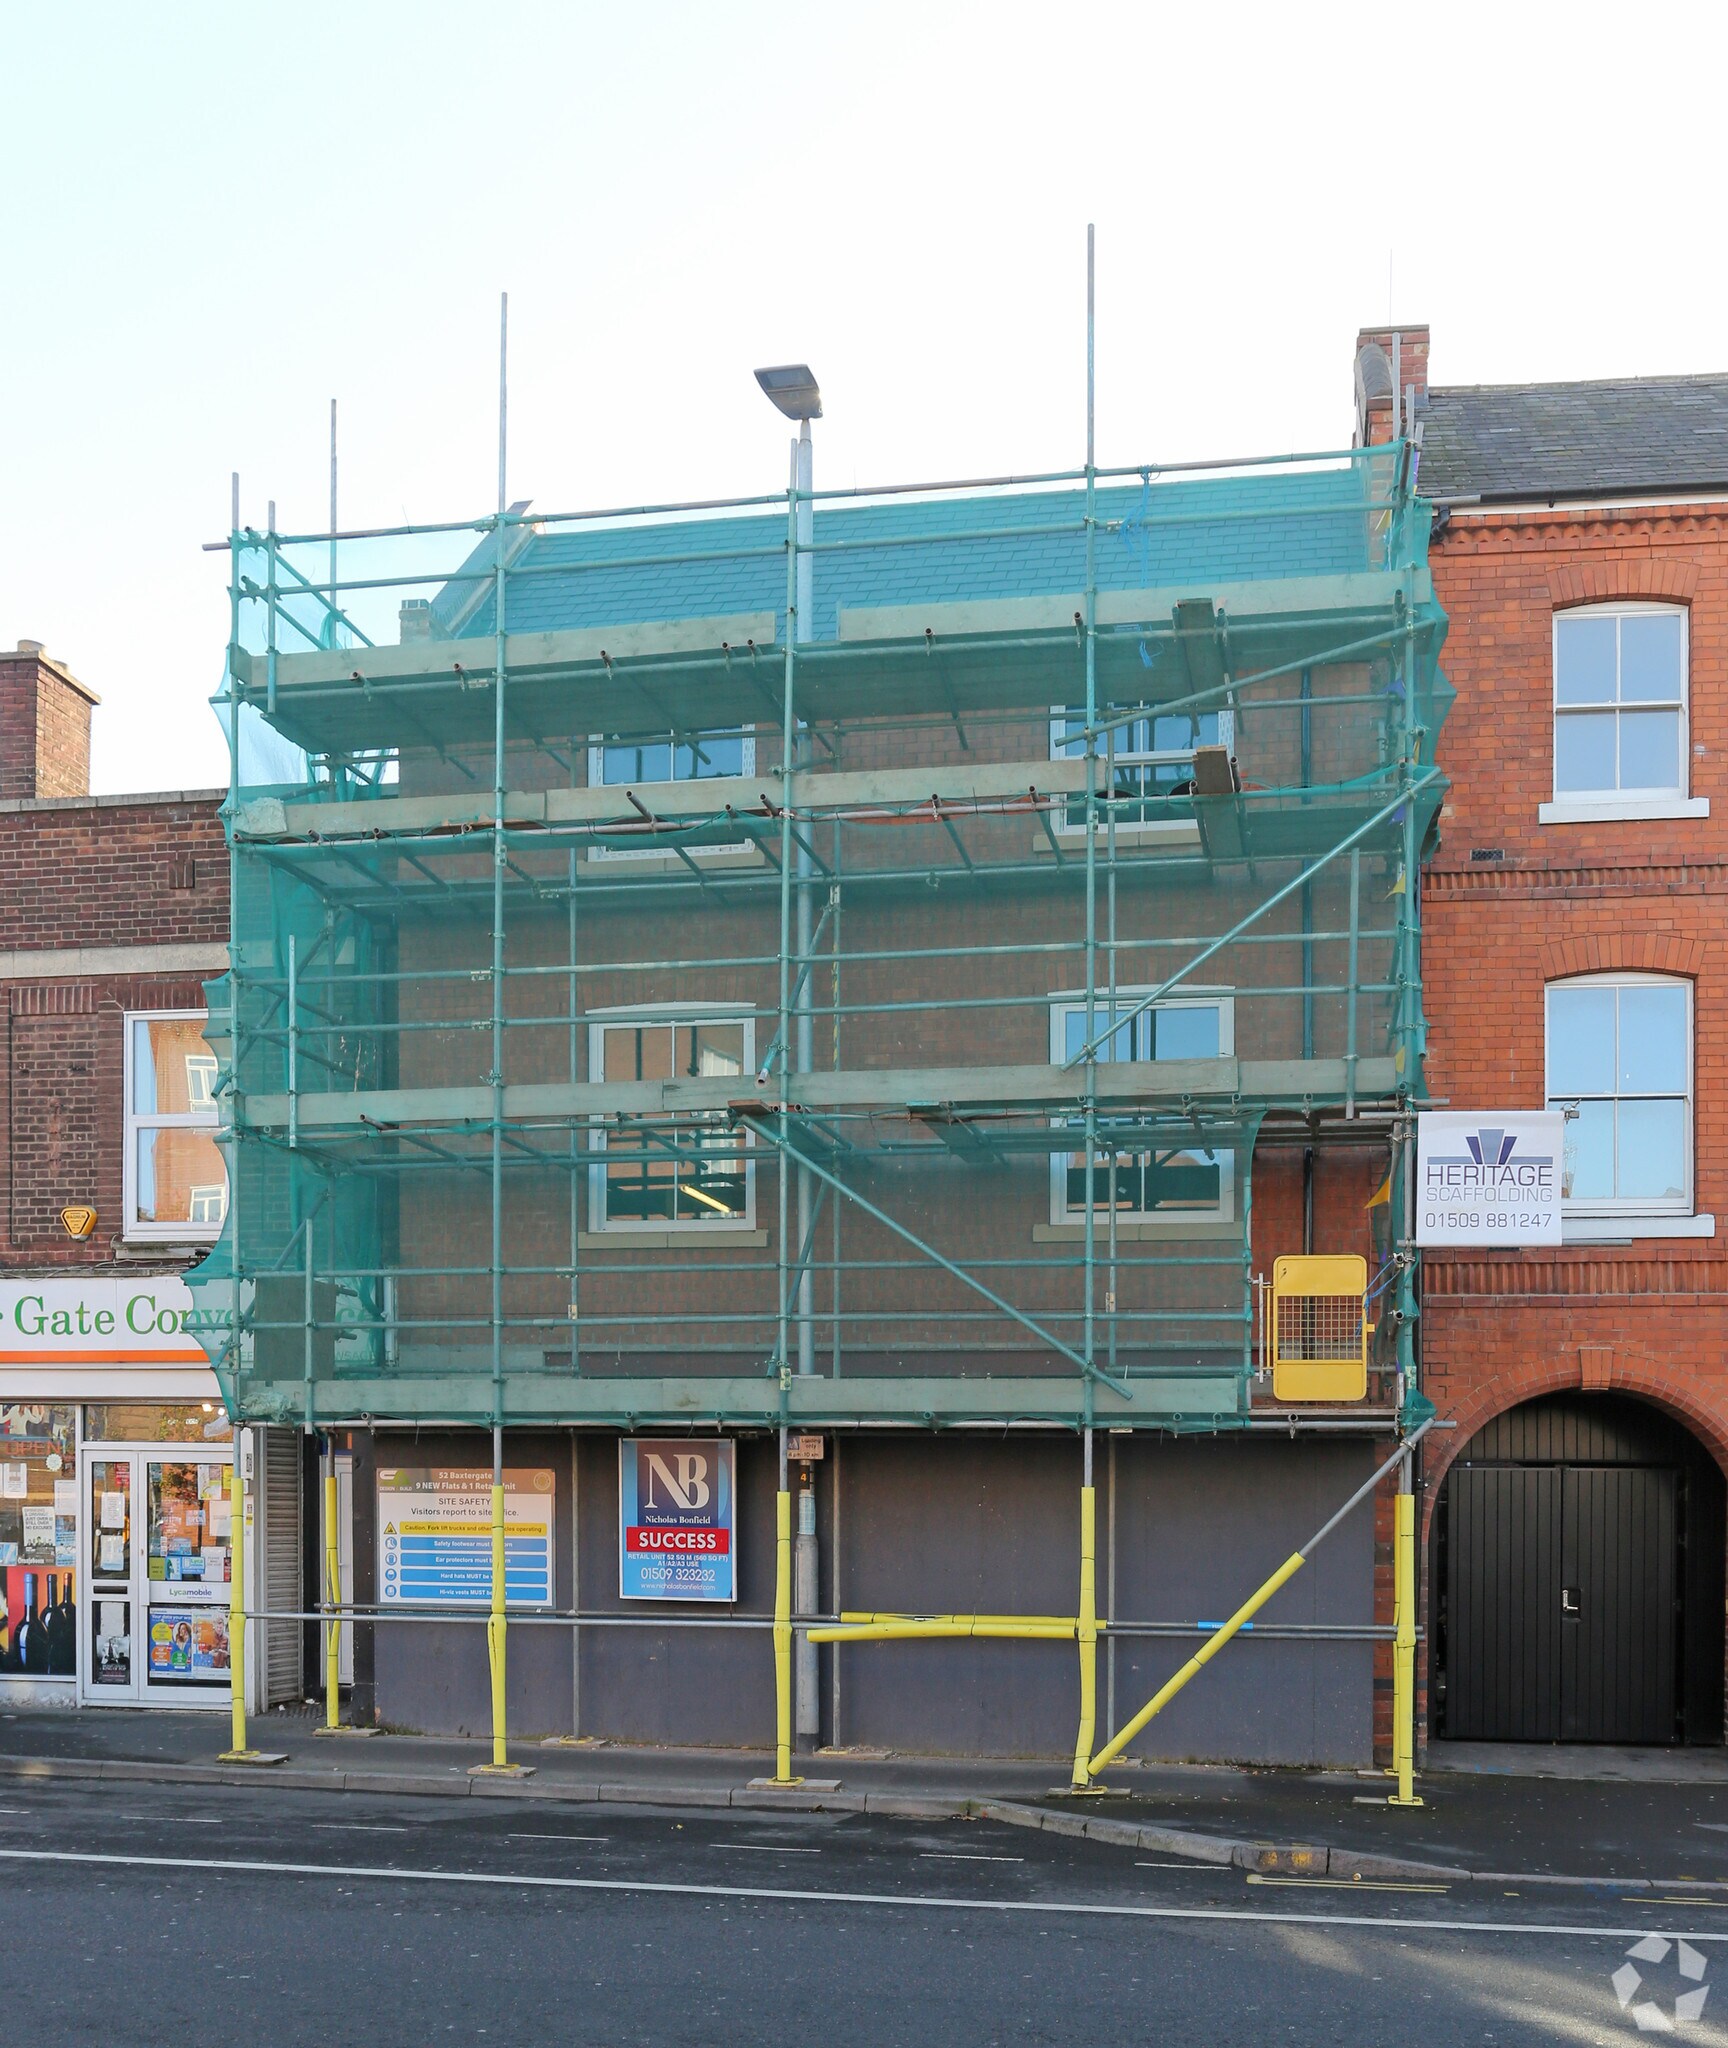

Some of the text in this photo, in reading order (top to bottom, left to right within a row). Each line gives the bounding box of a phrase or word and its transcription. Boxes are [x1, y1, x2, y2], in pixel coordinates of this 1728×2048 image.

[1427, 1165, 1553, 1186] HERITAGE
[1427, 1187, 1553, 1203] SCAFFOLDING
[1425, 1212, 1552, 1229] 01509 881247
[14, 1295, 116, 1336] Gate
[6, 1441, 61, 1455] OPEN
[438, 1471, 493, 1480] 52 Baxtergate
[800, 1473, 807, 1482] 4
[415, 1482, 421, 1490] 9
[422, 1482, 441, 1490] NEW
[442, 1482, 461, 1490] Flats
[461, 1482, 468, 1490] &
[469, 1482, 473, 1490] 1
[644, 1453, 710, 1509] NB
[438, 1497, 491, 1506] SITE SAFETY
[442, 1509, 467, 1517] report
[645, 1515, 711, 1525] Nicholas Bonfield
[638, 1531, 717, 1550] SUCCESS
[446, 1556, 474, 1564] protectors
[718, 1555, 728, 1563] FT)
[640, 1567, 716, 1582] 01509 323232
[640, 1582, 716, 1592] www.nicholasbonfield.com
[169, 1589, 212, 1597] Lycamobile
[470, 1589, 485, 1597] MUST
